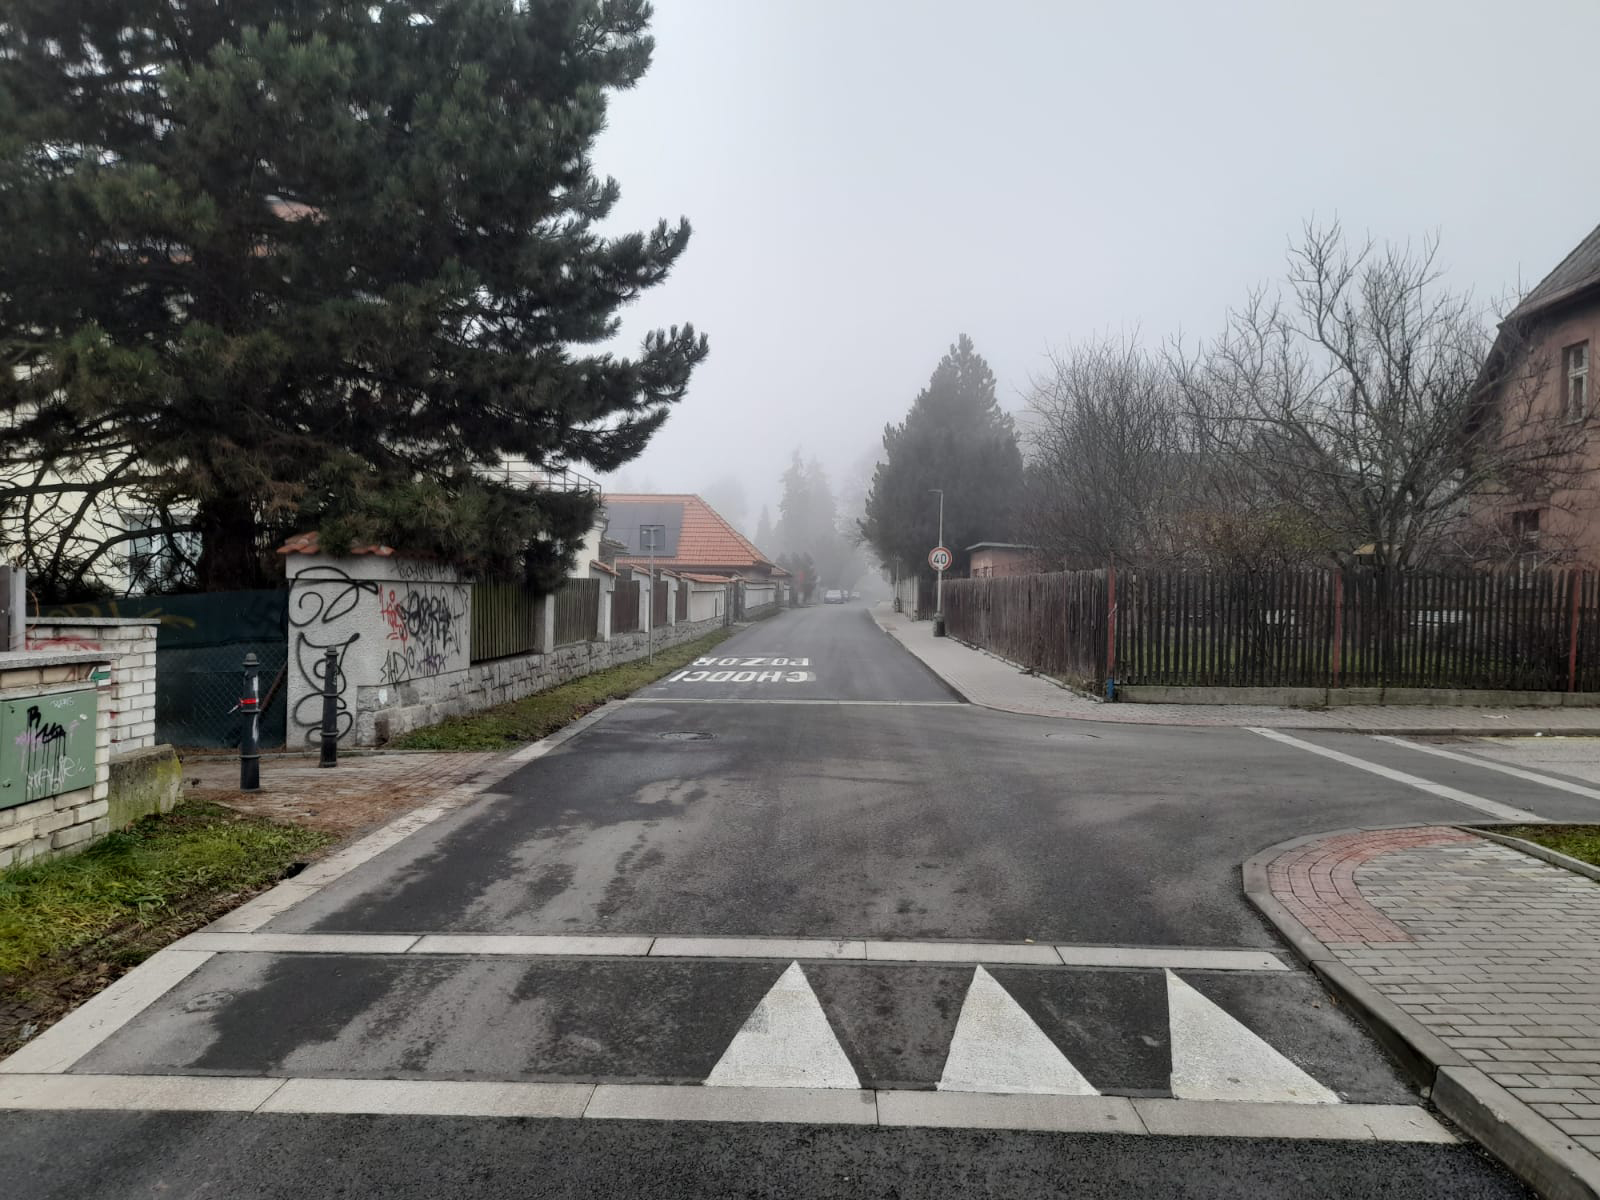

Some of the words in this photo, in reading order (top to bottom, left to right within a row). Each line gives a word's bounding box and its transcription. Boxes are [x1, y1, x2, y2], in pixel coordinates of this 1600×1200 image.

[933, 553, 947, 565] 40
[692, 657, 809, 666] POZOR
[668, 670, 811, 683] CHODCI
